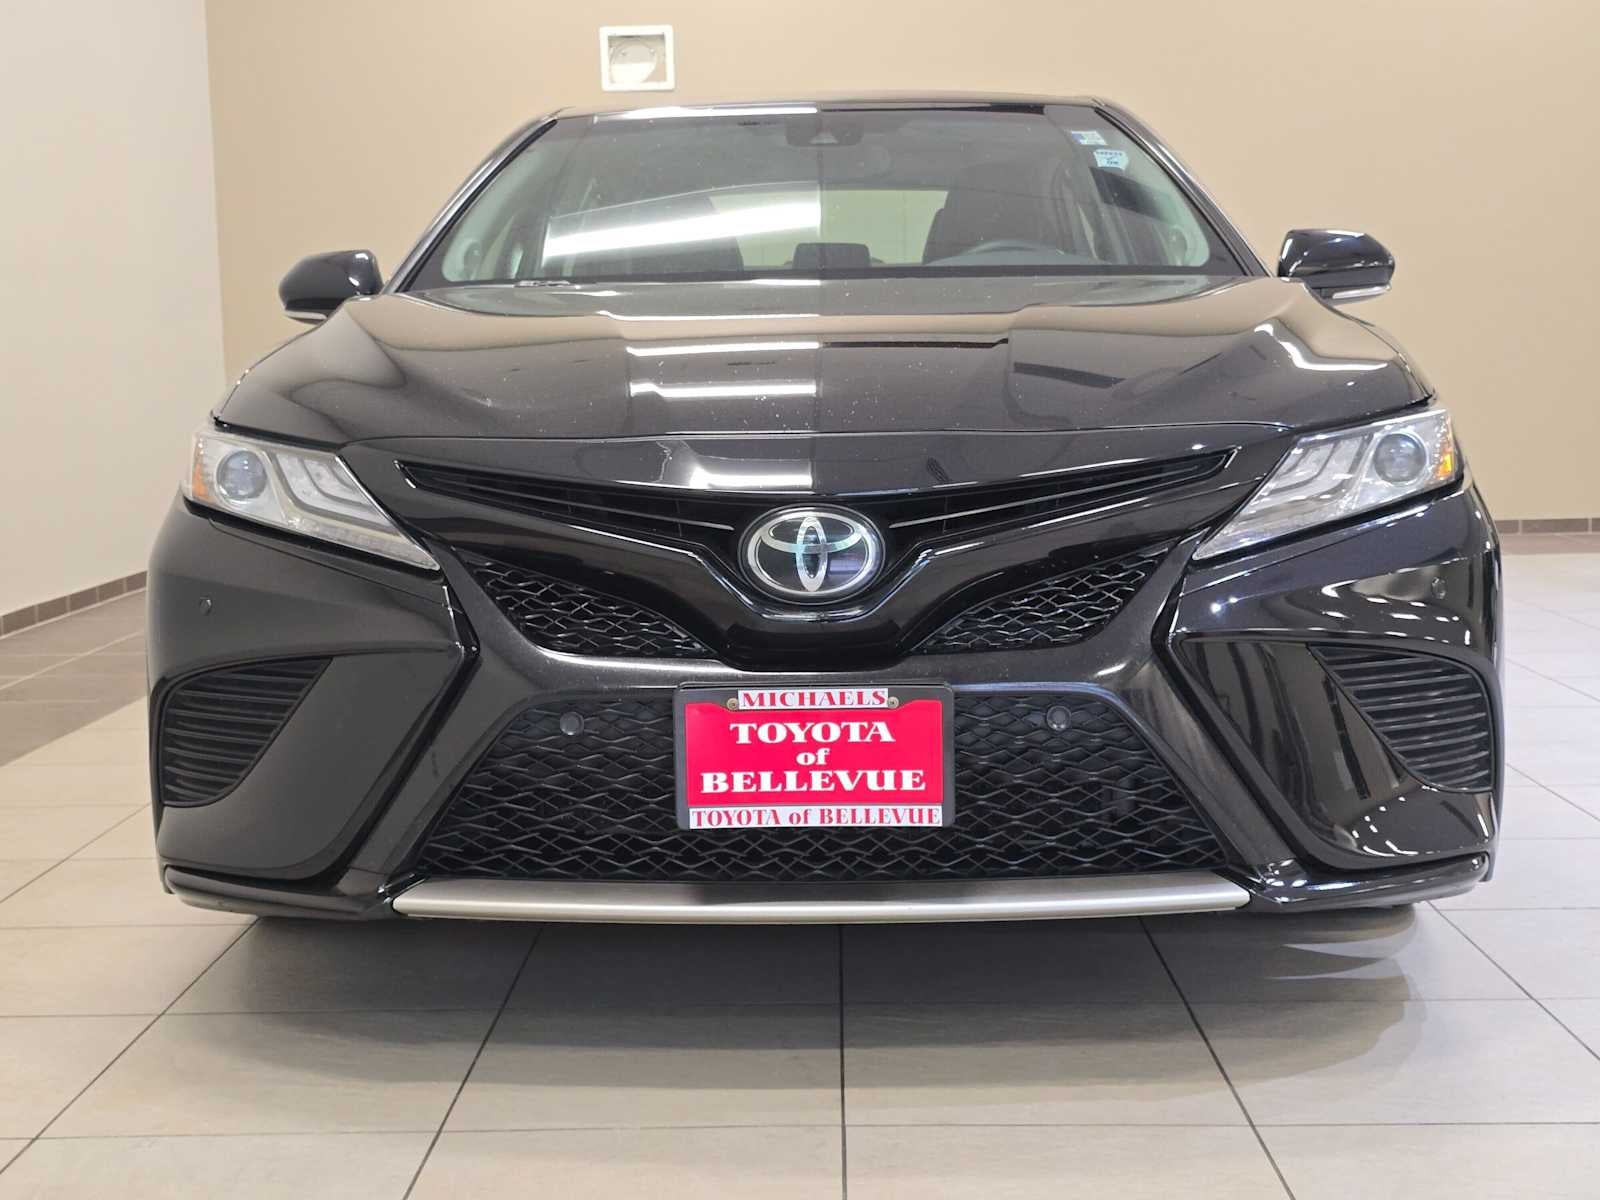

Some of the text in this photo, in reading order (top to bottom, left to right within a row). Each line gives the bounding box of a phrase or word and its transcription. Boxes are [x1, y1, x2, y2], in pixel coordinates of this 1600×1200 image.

[742, 690, 886, 707] MICHAELS
[729, 721, 896, 744] TOYOTA
[796, 747, 830, 765] of
[700, 769, 926, 793] BELLEVUE
[692, 808, 941, 827] TOYOTA of BELLEVUE
